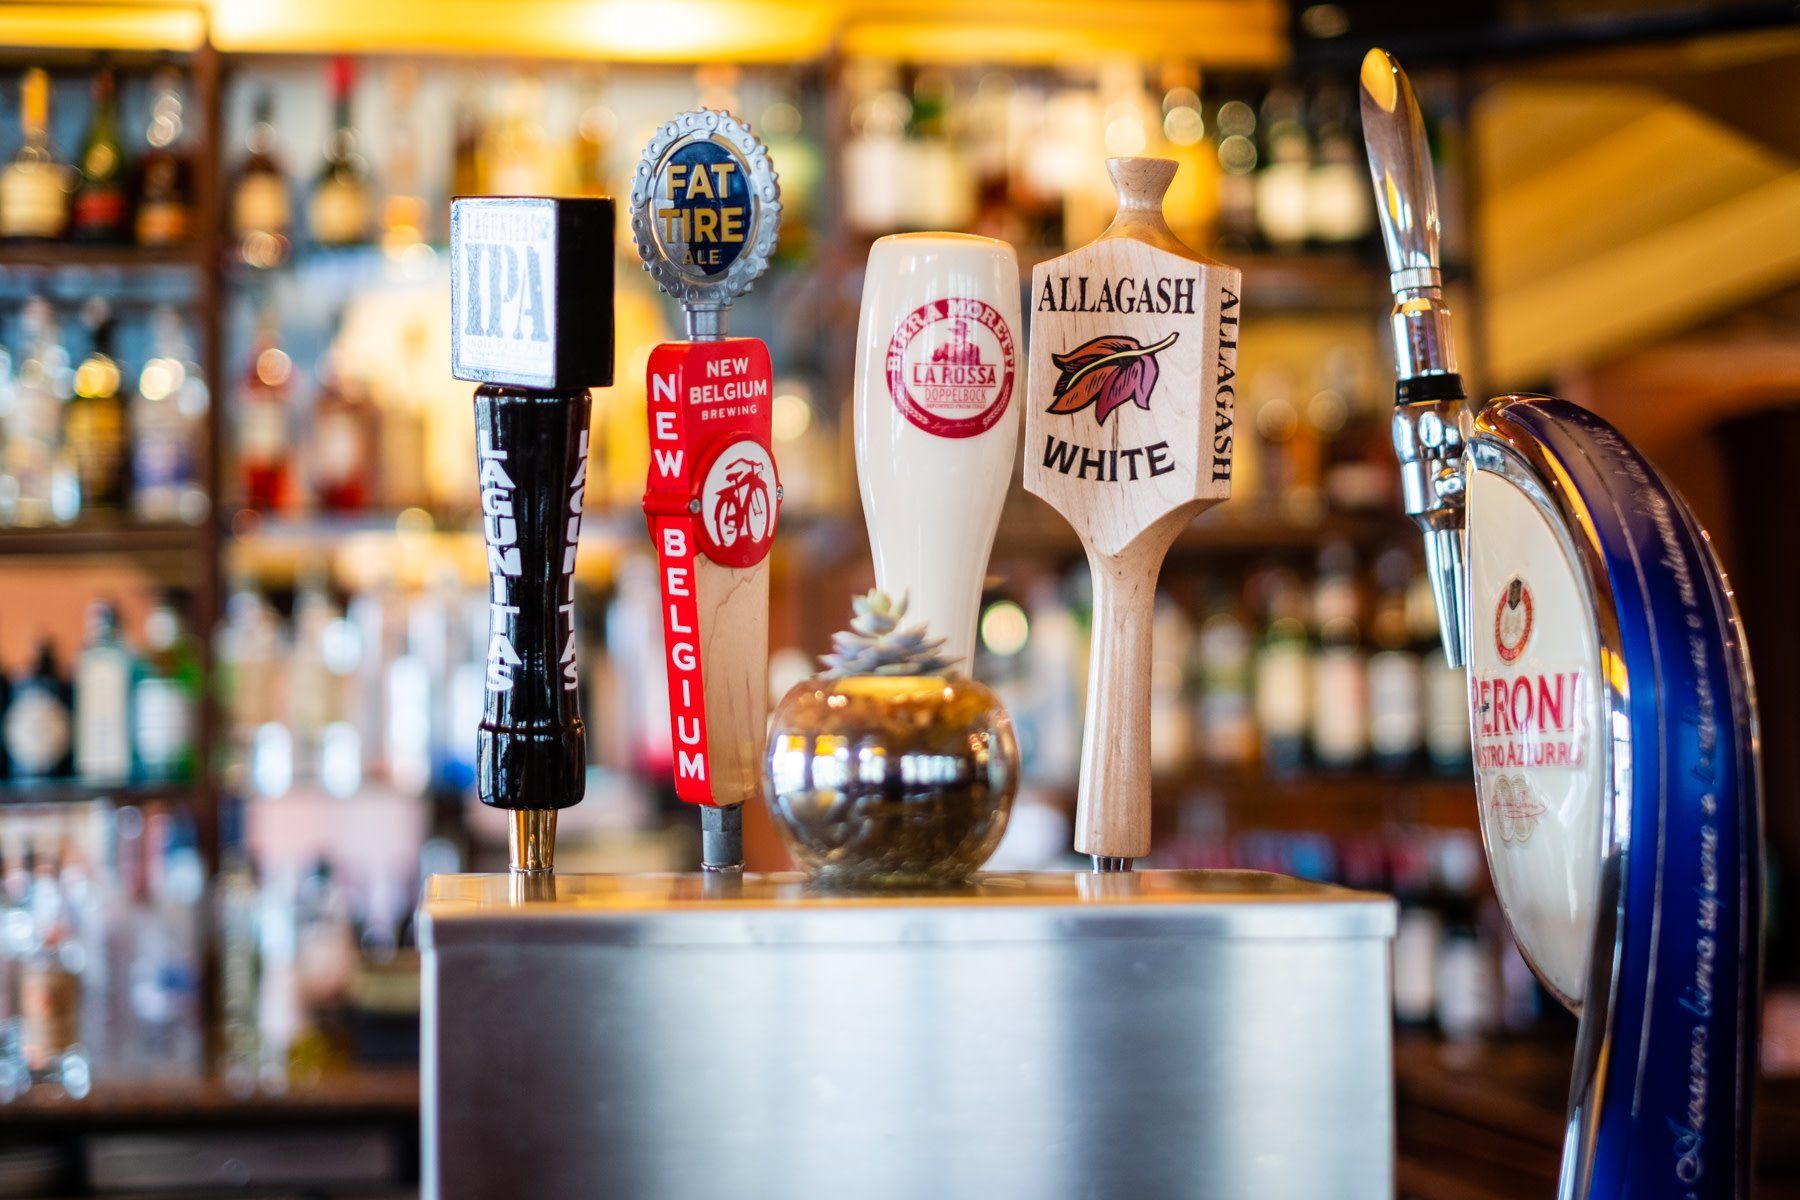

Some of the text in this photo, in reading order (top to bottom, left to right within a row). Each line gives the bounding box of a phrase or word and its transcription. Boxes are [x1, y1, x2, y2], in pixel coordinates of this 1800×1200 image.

[666, 162, 735, 200] FAT
[658, 207, 744, 243] TIRE
[683, 249, 720, 265] ALE
[465, 243, 549, 342] IPA
[1037, 274, 1196, 315] ALLAGASH
[706, 357, 749, 378] NEW
[914, 366, 996, 385] LA ROSSA
[1212, 287, 1240, 484] ALLAGASH
[689, 379, 767, 405] BELGIUM
[925, 388, 986, 402] DOPPELBOCK
[701, 404, 757, 420] BREWING
[1042, 434, 1176, 482] WHITE
[480, 429, 523, 691] LAGUNITAS
[653, 373, 705, 781] NEW BELGIUM
